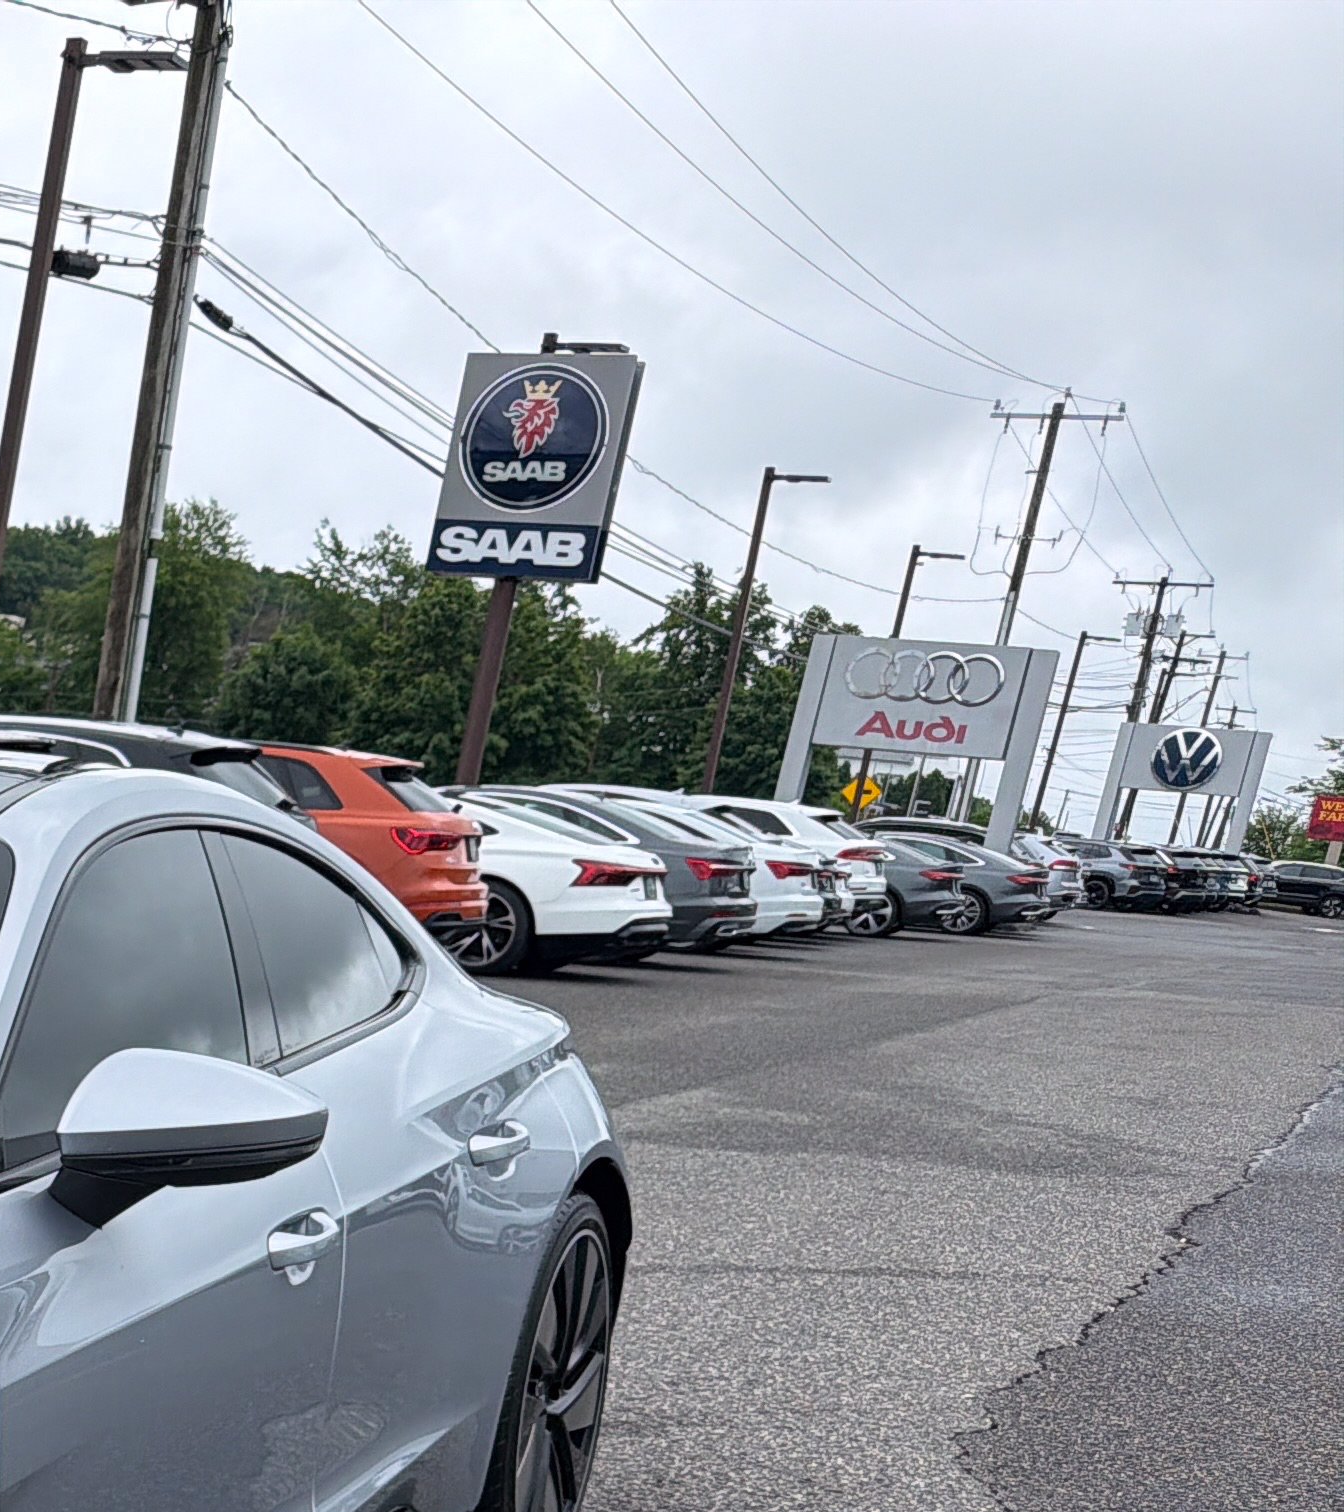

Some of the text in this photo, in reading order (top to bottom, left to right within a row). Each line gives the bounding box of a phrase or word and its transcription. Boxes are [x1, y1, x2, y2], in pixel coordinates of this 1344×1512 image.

[482, 460, 567, 482] SAAB
[435, 525, 587, 567] SAAB
[854, 710, 969, 745] Audi
